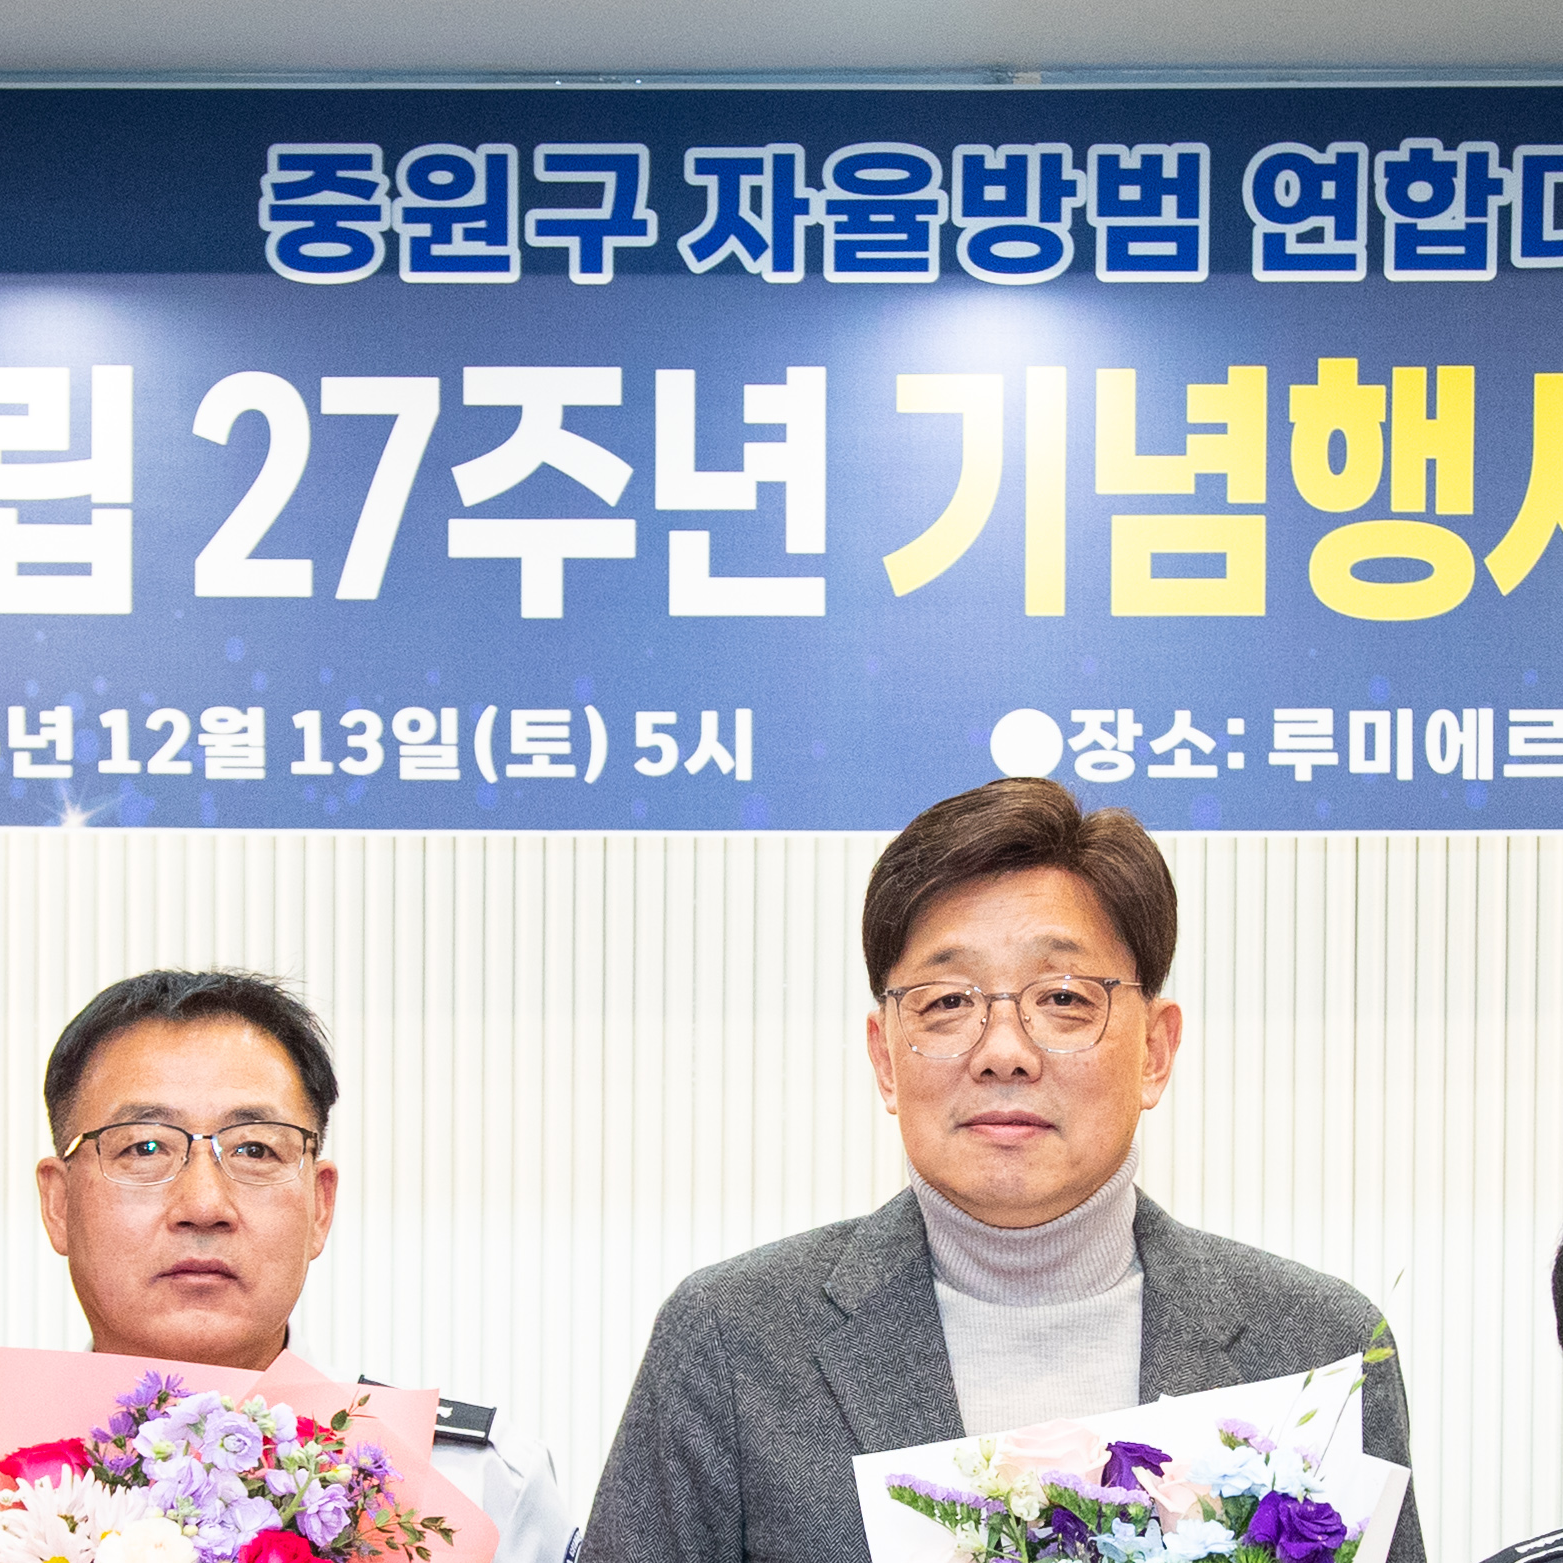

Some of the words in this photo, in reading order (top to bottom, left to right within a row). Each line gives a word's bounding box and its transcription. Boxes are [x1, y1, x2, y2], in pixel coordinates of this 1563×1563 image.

[259, 141, 657, 284] 중원구
[678, 141, 1210, 285] 자율방범
[191, 365, 827, 618] 27주년
[97, 705, 265, 780] 12월
[290, 703, 608, 784] 13일(토)
[633, 707, 754, 781] 5시
[1066, 708, 1245, 783] 장소:
